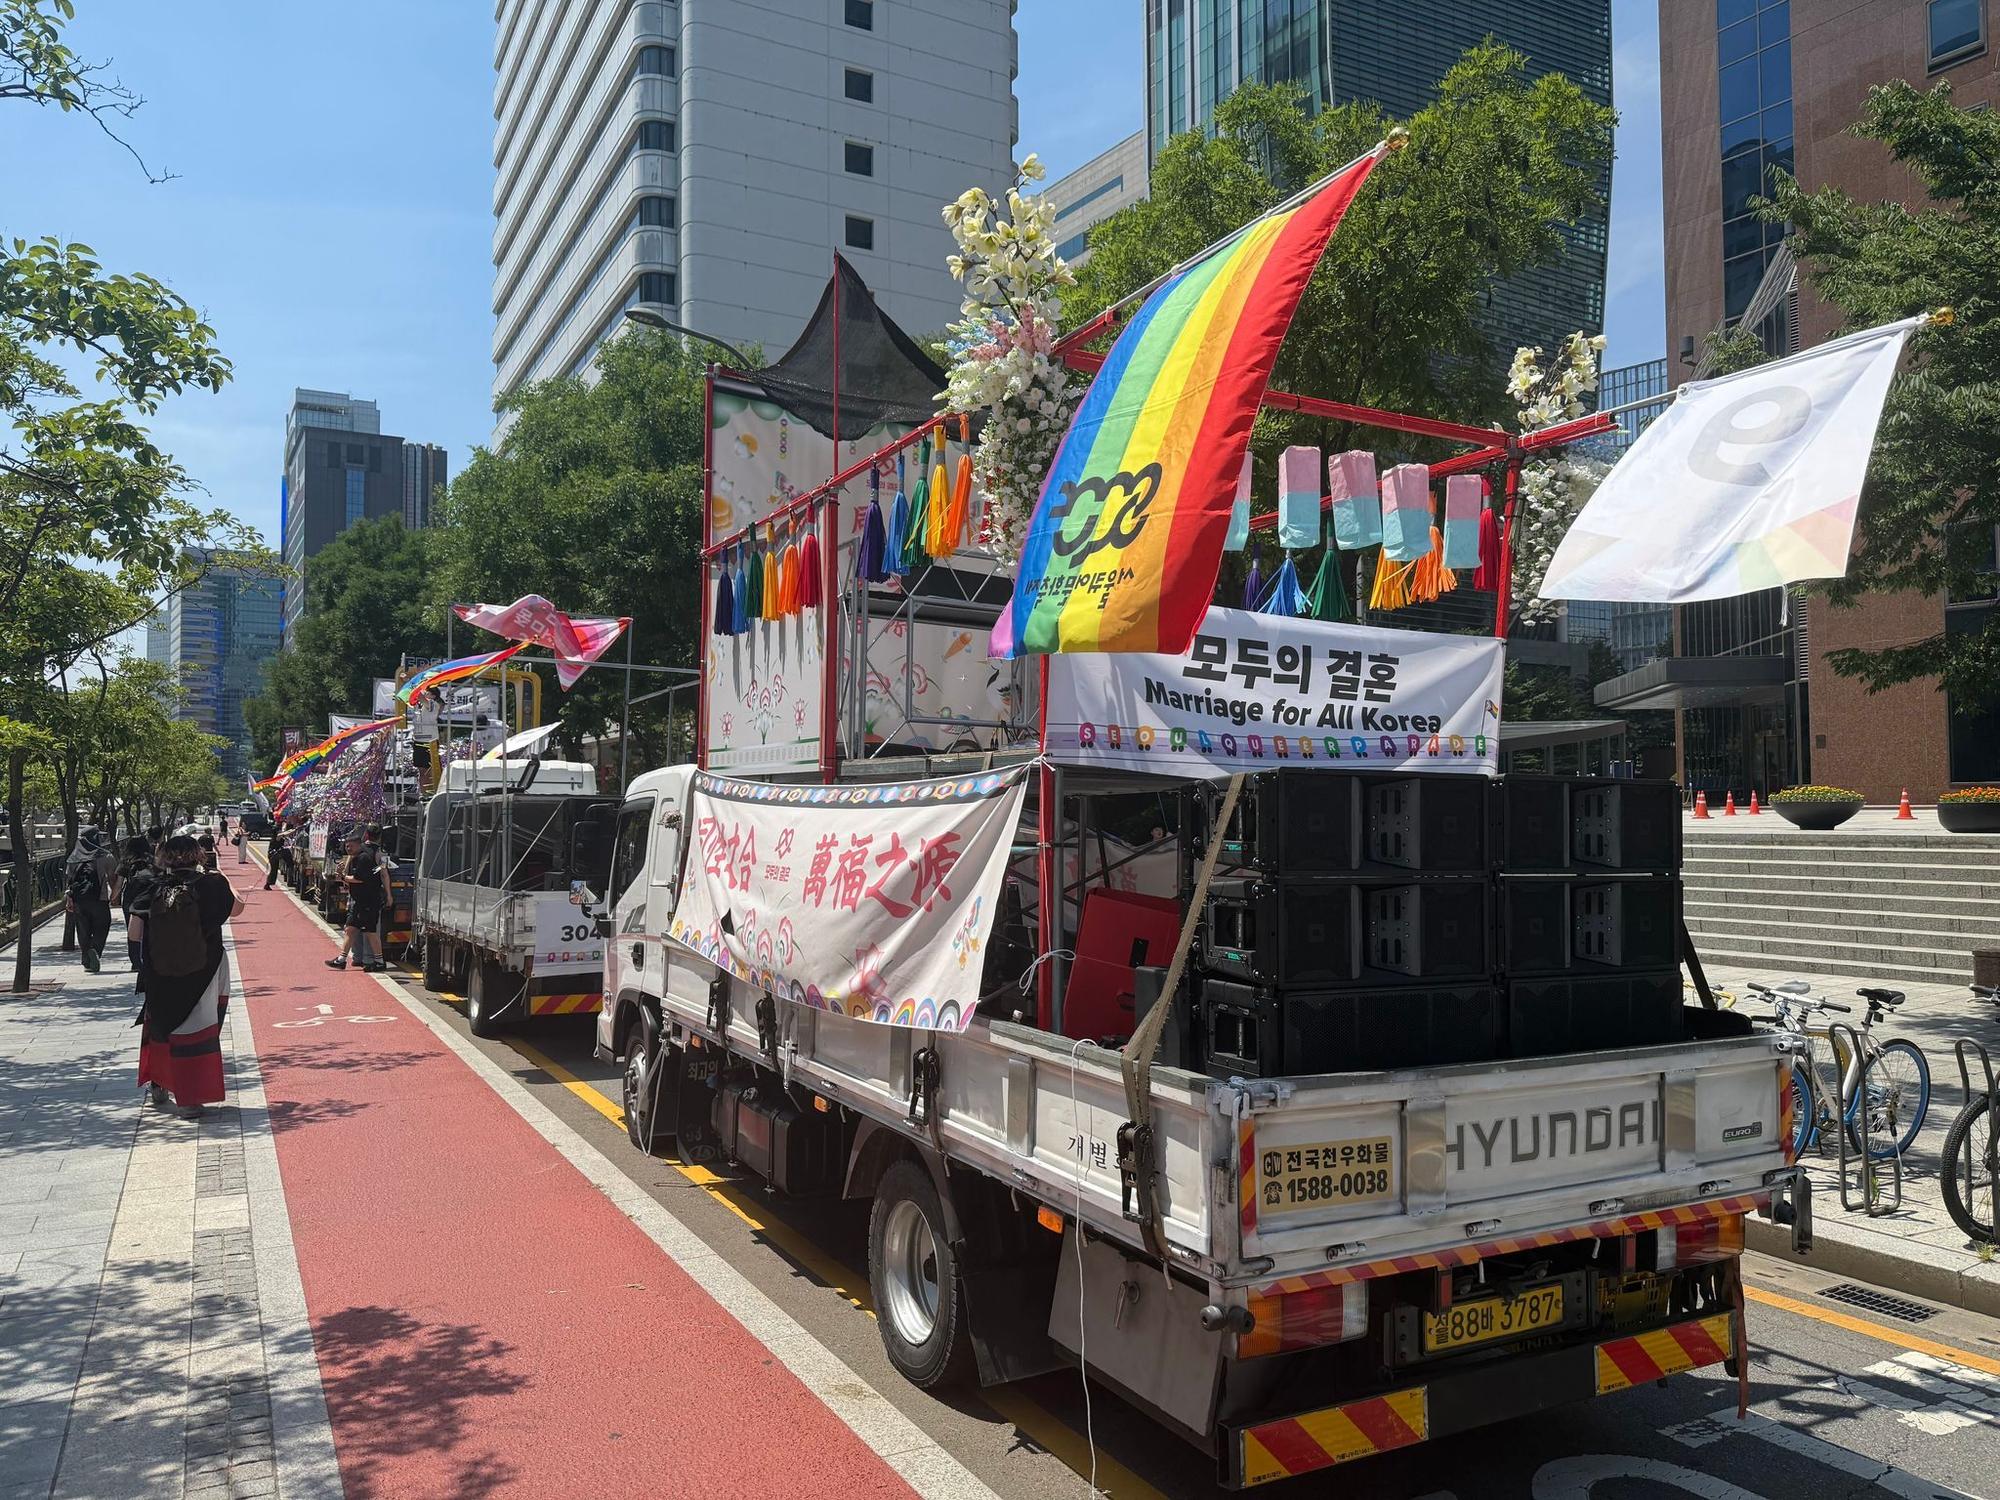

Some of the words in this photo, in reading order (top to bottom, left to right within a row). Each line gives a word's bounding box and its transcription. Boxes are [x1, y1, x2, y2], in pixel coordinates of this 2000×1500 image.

[1182, 634, 1312, 694] 모두의
[1326, 649, 1400, 703] 결혼
[1144, 677, 1264, 726] Marriage
[1272, 698, 1312, 726] for
[1316, 703, 1354, 730] All
[1361, 706, 1441, 735] Korea
[1724, 1128, 1751, 1137] EURO
[1286, 1142, 1388, 1172] 전국천우화물
[1286, 1169, 1388, 1203] 1588-0038
[1500, 1291, 1555, 1330] 3787
